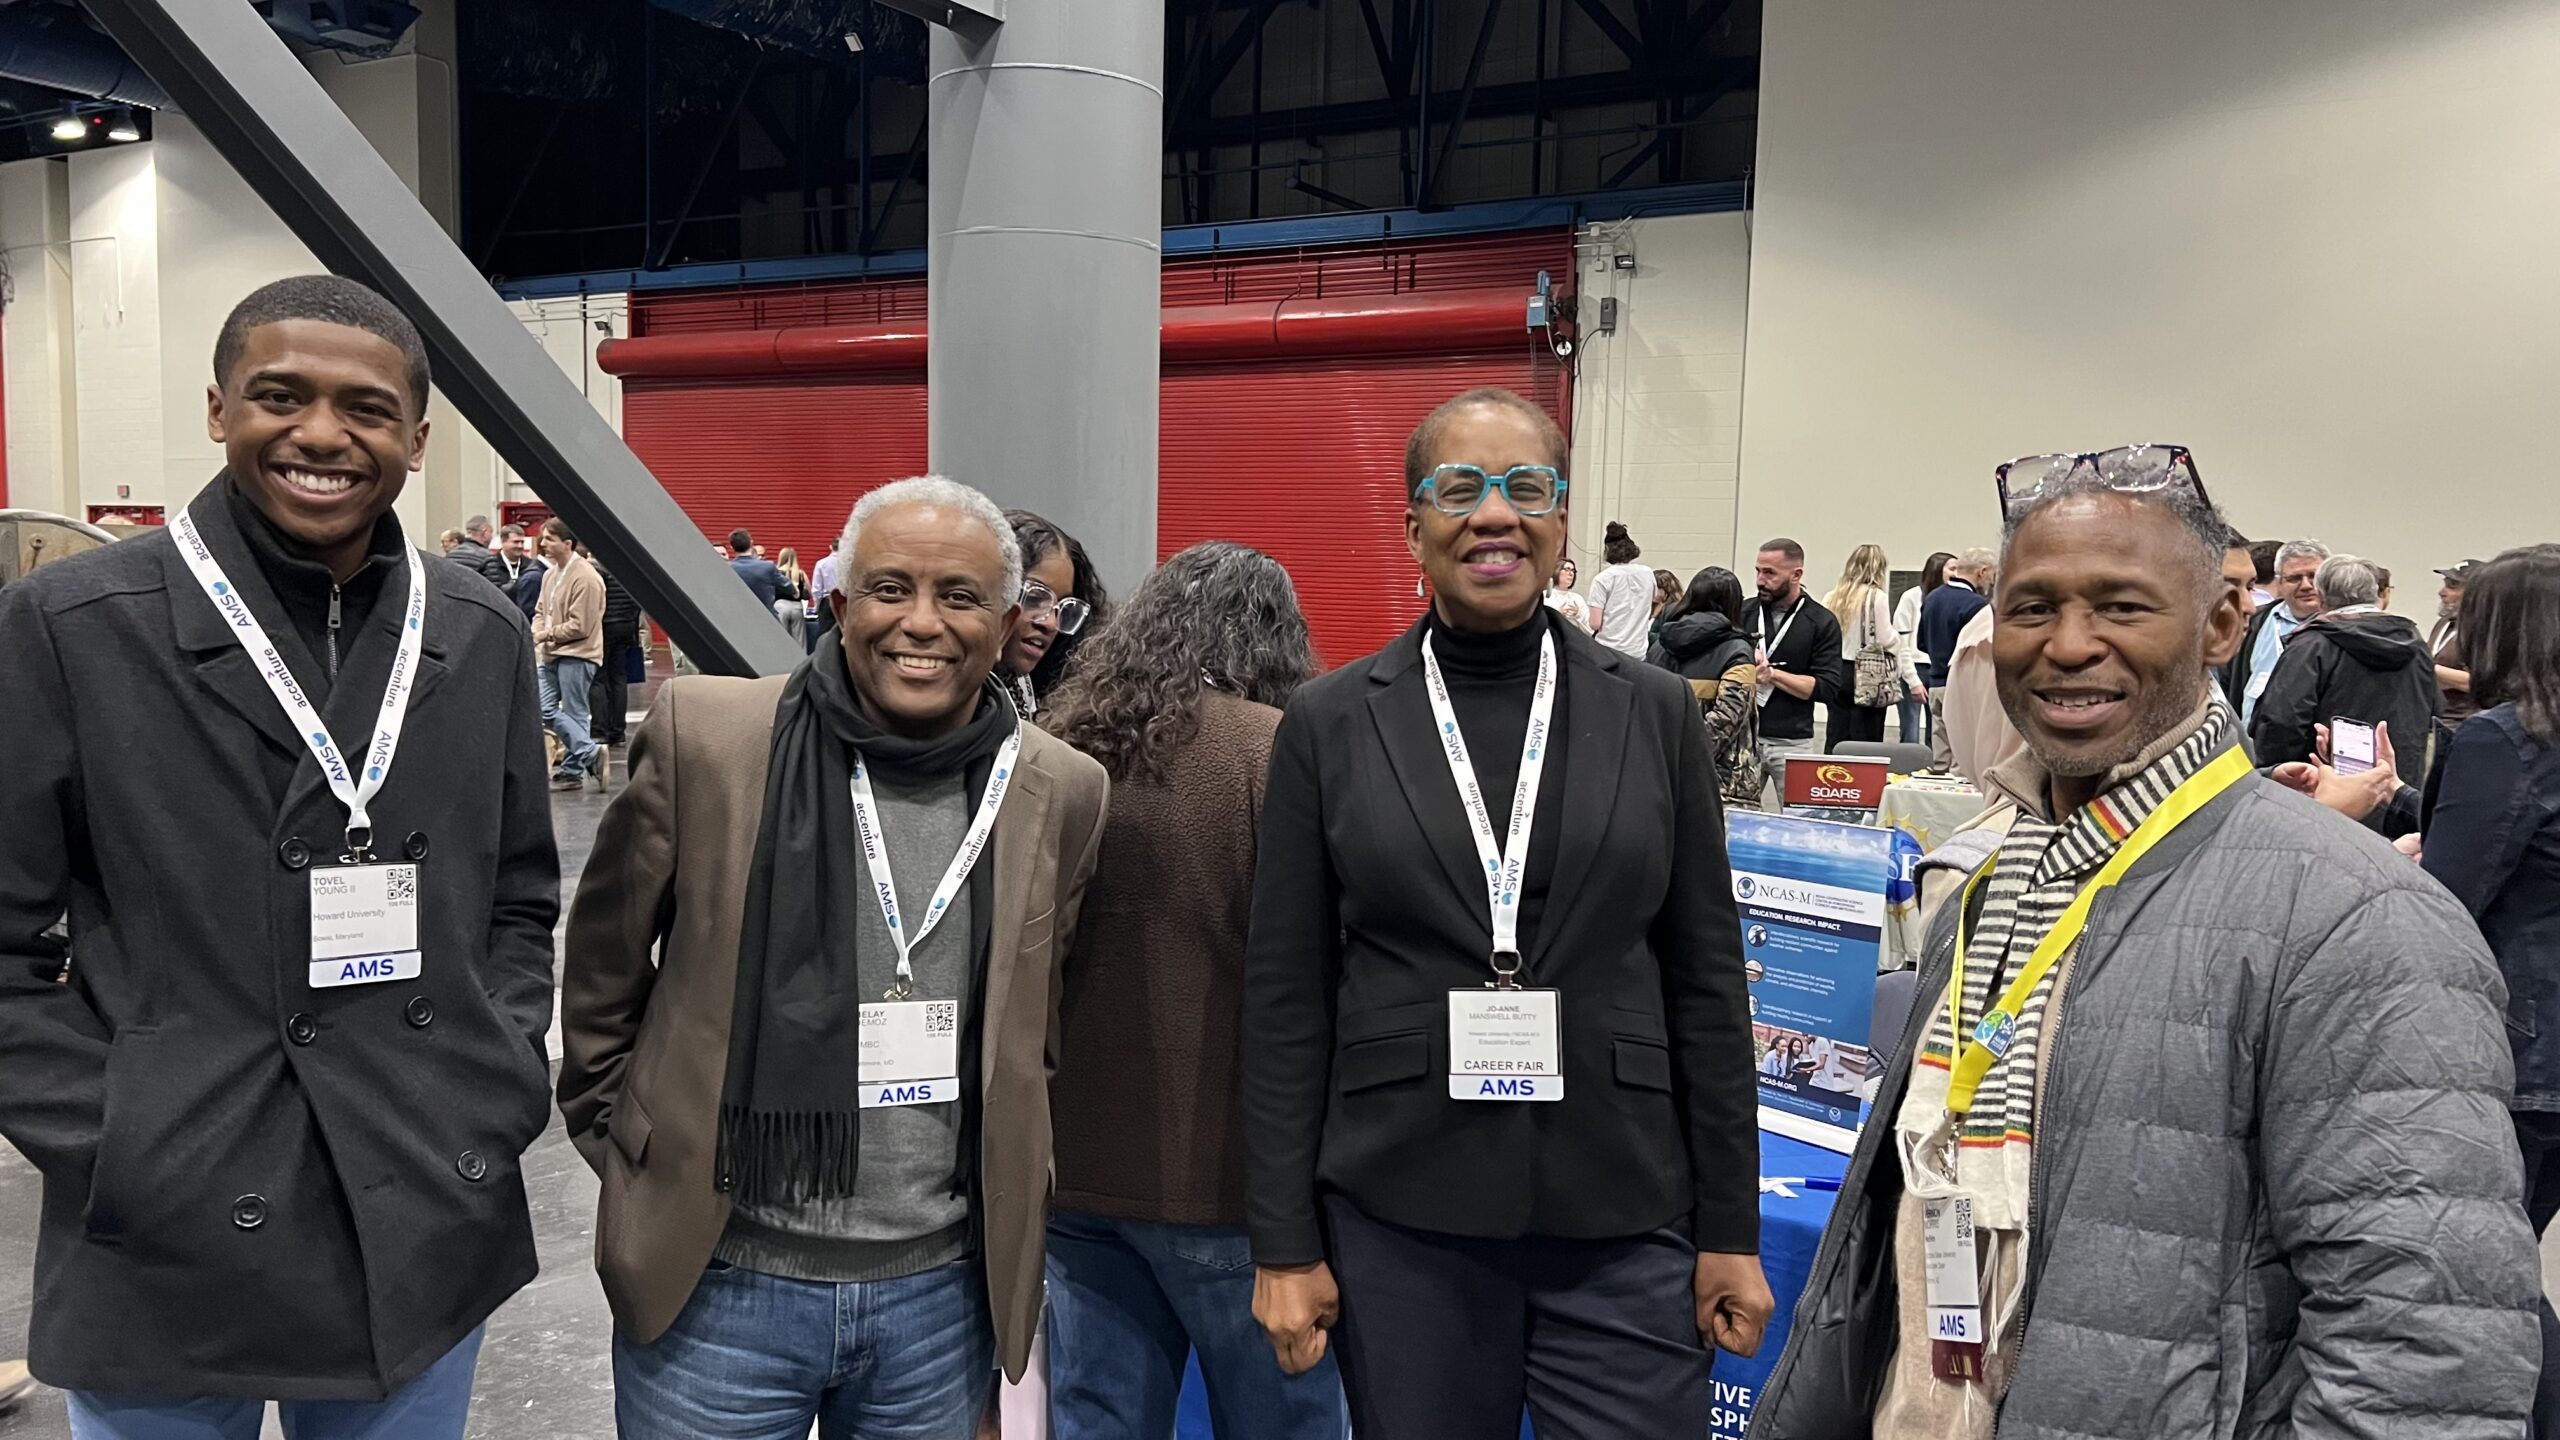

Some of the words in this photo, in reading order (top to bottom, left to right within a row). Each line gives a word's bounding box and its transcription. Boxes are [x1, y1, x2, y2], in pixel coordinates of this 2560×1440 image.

[179, 516, 209, 561] accenture
[219, 594, 252, 627] AMS
[410, 587, 423, 619] AMS
[264, 648, 307, 709] accenture
[385, 648, 409, 708] accenture
[1428, 654, 1447, 702] accenture
[372, 730, 393, 767] AMS
[1446, 733, 1465, 763] AMS
[1529, 718, 1545, 750] AMS
[320, 745, 346, 782] AMS
[987, 779, 1005, 810] AMS
[1511, 781, 1528, 836] accenture
[1810, 787, 1861, 799] SOARS
[1467, 782, 1491, 836] accenture
[856, 803, 876, 860] accenture
[957, 828, 988, 880] accenture
[313, 877, 345, 885] TOVEL
[1504, 857, 1520, 892] AMS
[313, 886, 348, 895] YOUNG
[878, 881, 895, 915] AMS
[1760, 884, 1811, 905] NCAS-M
[313, 912, 345, 921] Howard
[347, 909, 385, 918] University
[340, 959, 394, 980] AMS
[859, 1010, 885, 1019] ELAY
[1464, 1060, 1513, 1071] CAREER
[1517, 1061, 1544, 1071] FAIR
[879, 1085, 932, 1104] AMS
[1479, 1079, 1535, 1096] AMS
[1760, 1076, 1798, 1092] NCAS-M.ORG
[1939, 1314, 1966, 1337] AMS
[1709, 1379, 1751, 1408] IVE
